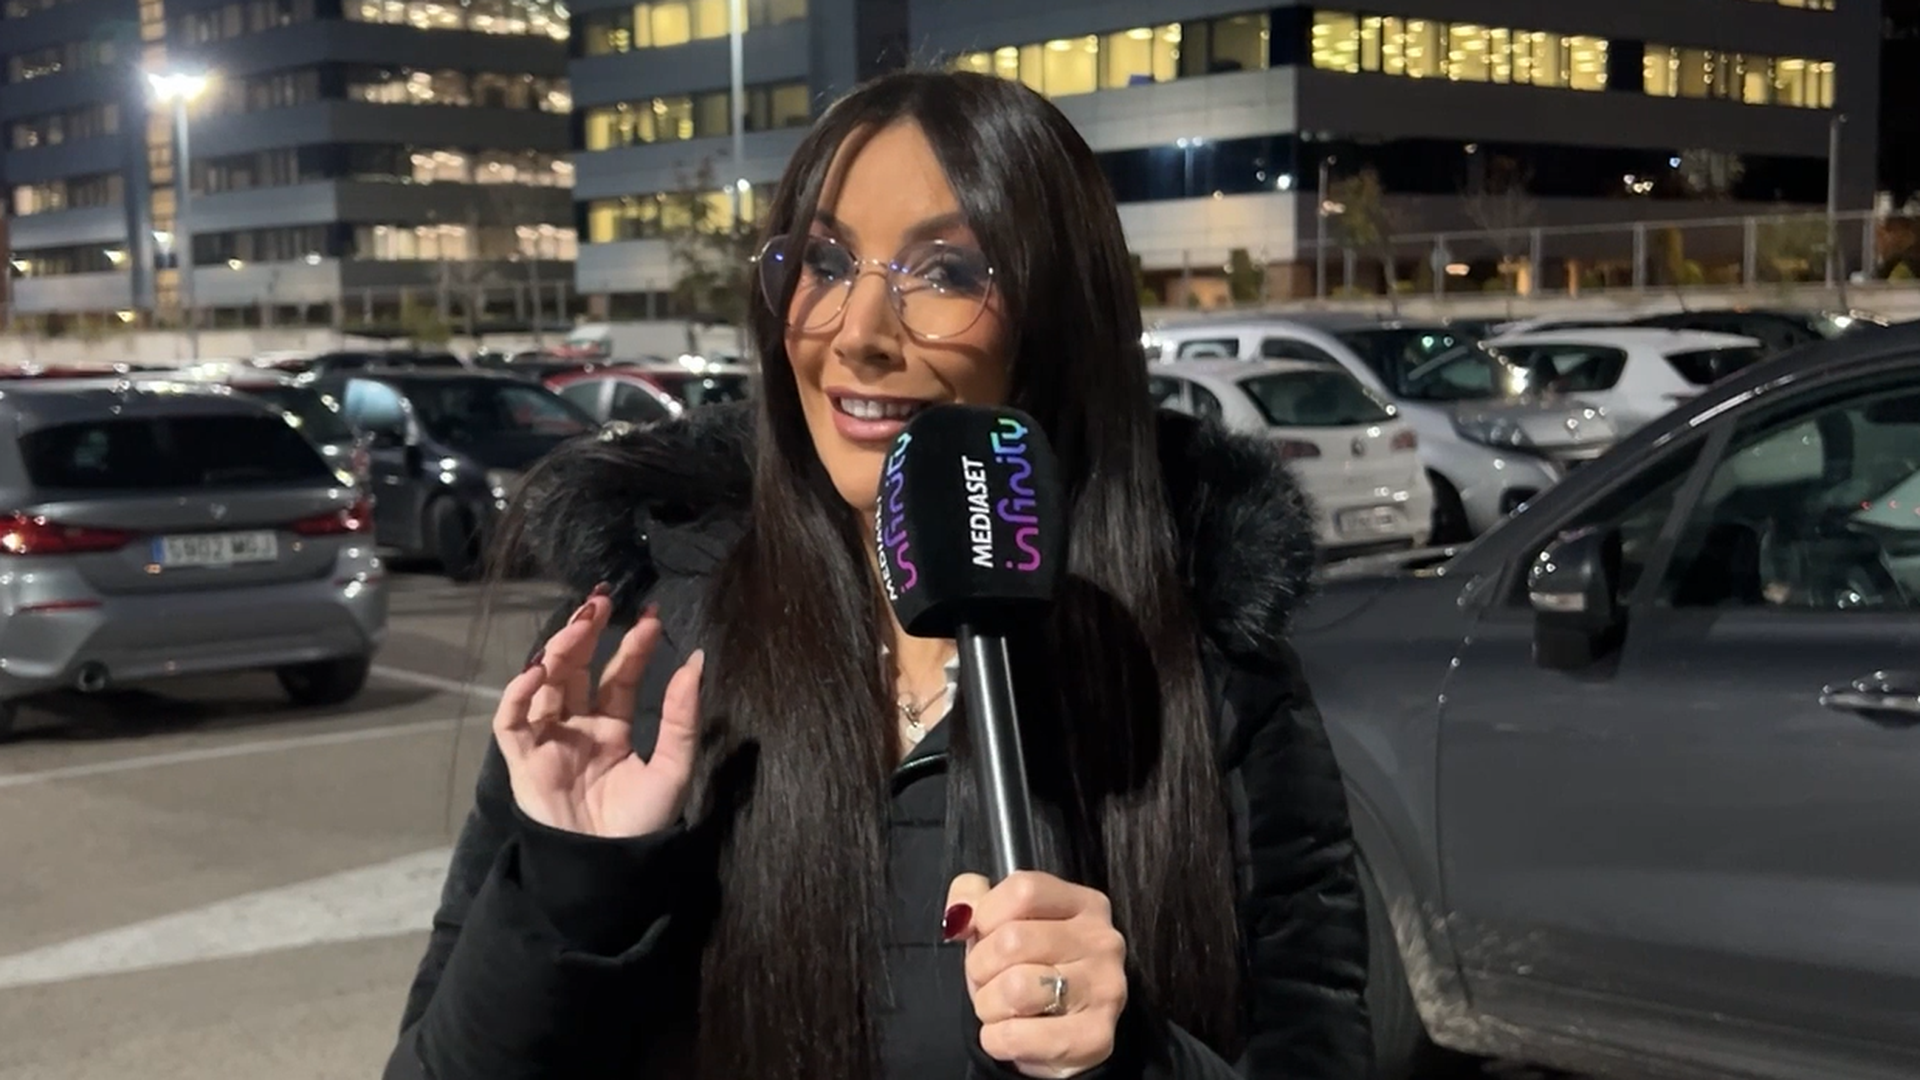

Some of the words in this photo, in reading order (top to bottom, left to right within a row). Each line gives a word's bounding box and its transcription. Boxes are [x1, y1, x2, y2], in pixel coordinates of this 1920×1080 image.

[884, 432, 917, 593] infinity
[961, 455, 994, 568] MEDIASET
[990, 418, 1041, 571] infinity
